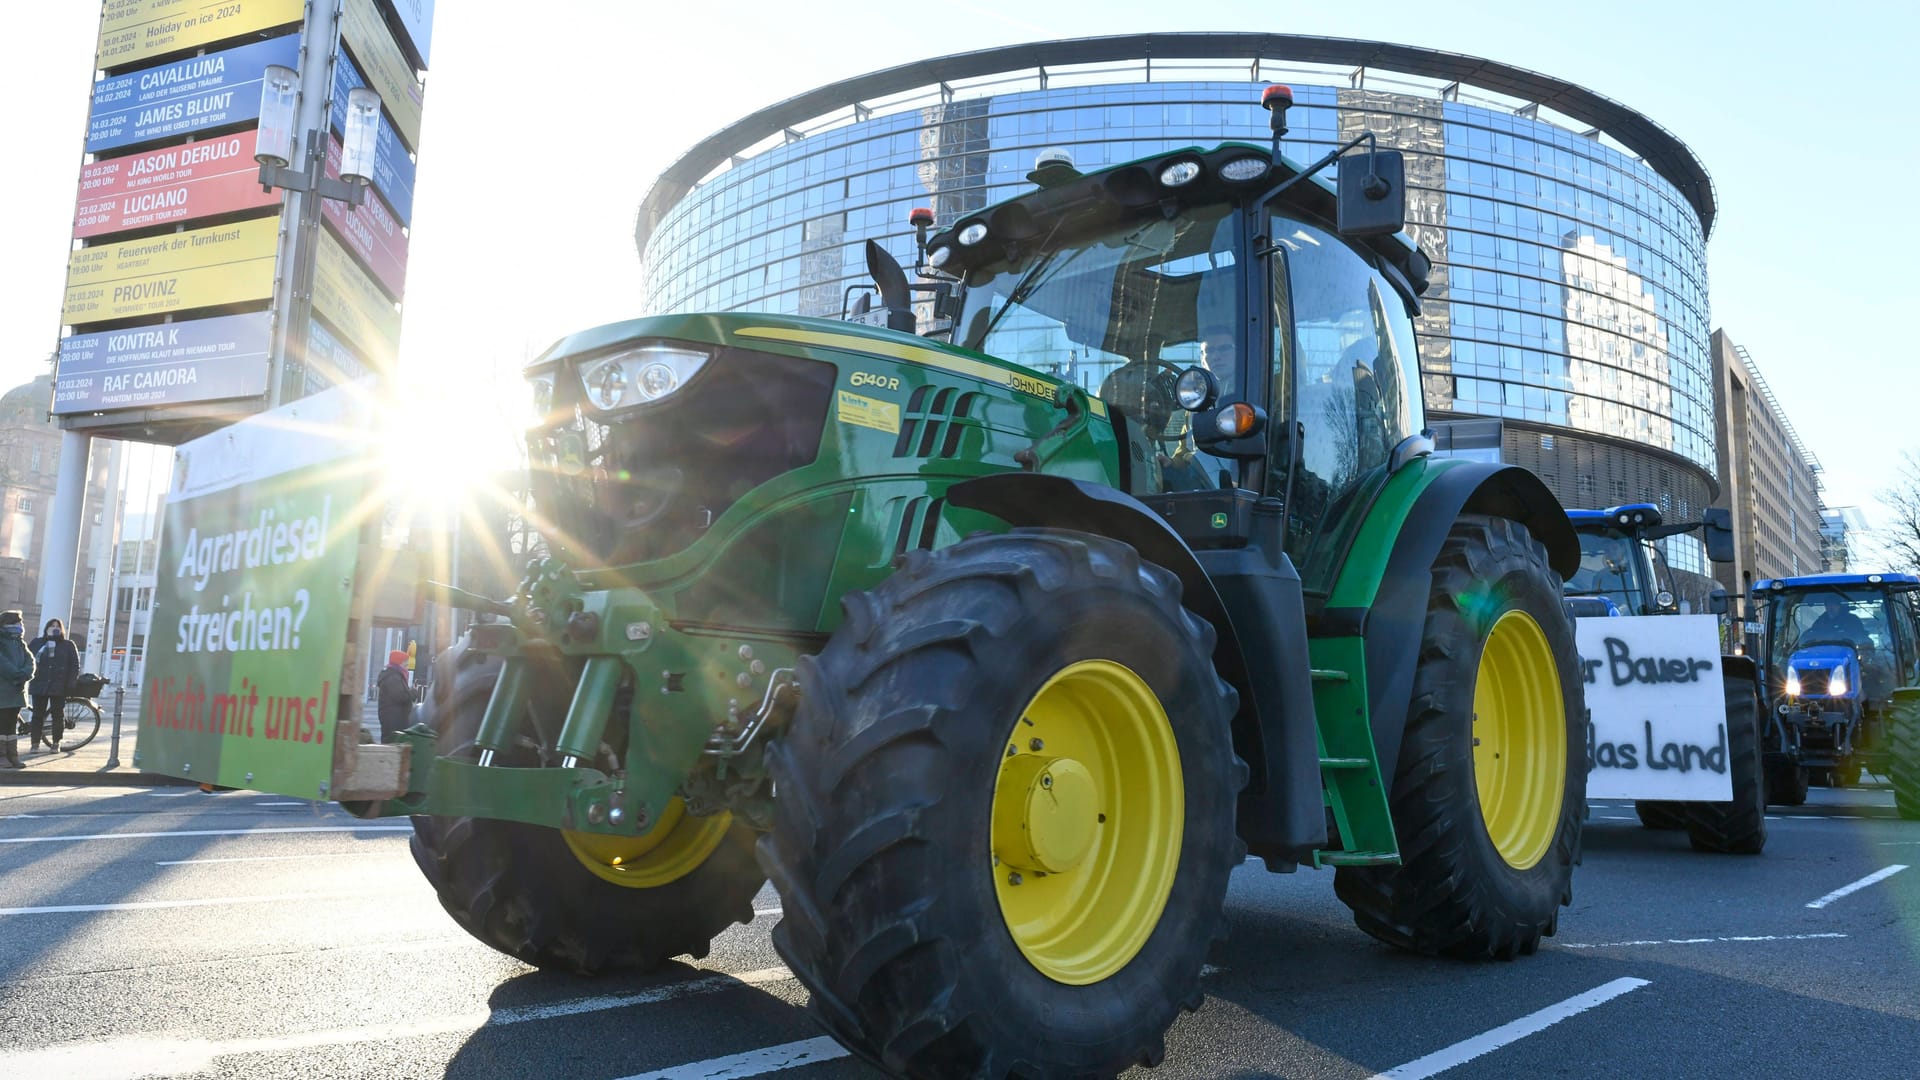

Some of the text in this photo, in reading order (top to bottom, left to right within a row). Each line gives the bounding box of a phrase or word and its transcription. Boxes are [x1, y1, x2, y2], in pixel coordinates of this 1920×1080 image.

[146, 4, 241, 38] Holiday on ice 2024
[104, 32, 136, 47] 10.01.2024
[145, 35, 175, 48] NO LIMITS
[102, 43, 135, 57] 14.01.2024
[140, 57, 225, 90] CAVALLUNA
[96, 78, 132, 93] 02.02.2024
[139, 75, 223, 101] LAND DER TAUSEND TRÄUME
[135, 92, 234, 127] JAMES BLUNT
[92, 115, 127, 130] 14.03.2024
[134, 112, 226, 138] THE WHO WE USED TO BE TOUR
[90, 128, 122, 141] 20:00 Uhr
[127, 139, 240, 177] JASON DERULO
[84, 164, 119, 178] 19.03.2024
[375, 151, 393, 186] BLUNT
[82, 176, 115, 190] 20:00 Uhr
[127, 169, 192, 188] NU KING WORLD TOUR
[79, 201, 116, 215] 23.02.2024
[123, 188, 188, 215] LUCIANO
[78, 214, 110, 227] 20:00 Uhr
[122, 208, 187, 226] SEDUCTIVE TOUR 2024
[371, 201, 394, 237] DERULO
[346, 209, 374, 251] LUCIANO
[118, 229, 241, 259] Feuerwerk der Turnkunst
[72, 263, 103, 275] 19:00 Uhr
[117, 258, 150, 270] HEARTBEAT
[69, 289, 104, 302] 21.03.2024
[113, 278, 177, 303] PROVINZ
[67, 302, 100, 313] 20:00 Uhr
[148, 301, 165, 310] TOUR
[165, 298, 180, 308] 2024
[63, 338, 99, 350] 16.03.2024
[108, 328, 180, 352] KONTRA K
[61, 351, 94, 362] 20:00 Uhr
[106, 342, 236, 364] DIE HOFFNUNG KLAUT MIR NIEMAND TOUR
[58, 378, 93, 390] 17.03.2024
[103, 367, 197, 392] RAF CAMORA
[1006, 374, 1056, 398] JOHN DEE
[56, 390, 90, 402] 20:00 Uhr
[102, 390, 166, 404] PHANTOM TOUR 2024
[176, 494, 332, 592] Agrardiesel
[175, 588, 310, 653] streichen?
[1583, 637, 1713, 686] r Bauer
[146, 676, 329, 745] Nicht mit uns!
[1645, 720, 1728, 775] Land
